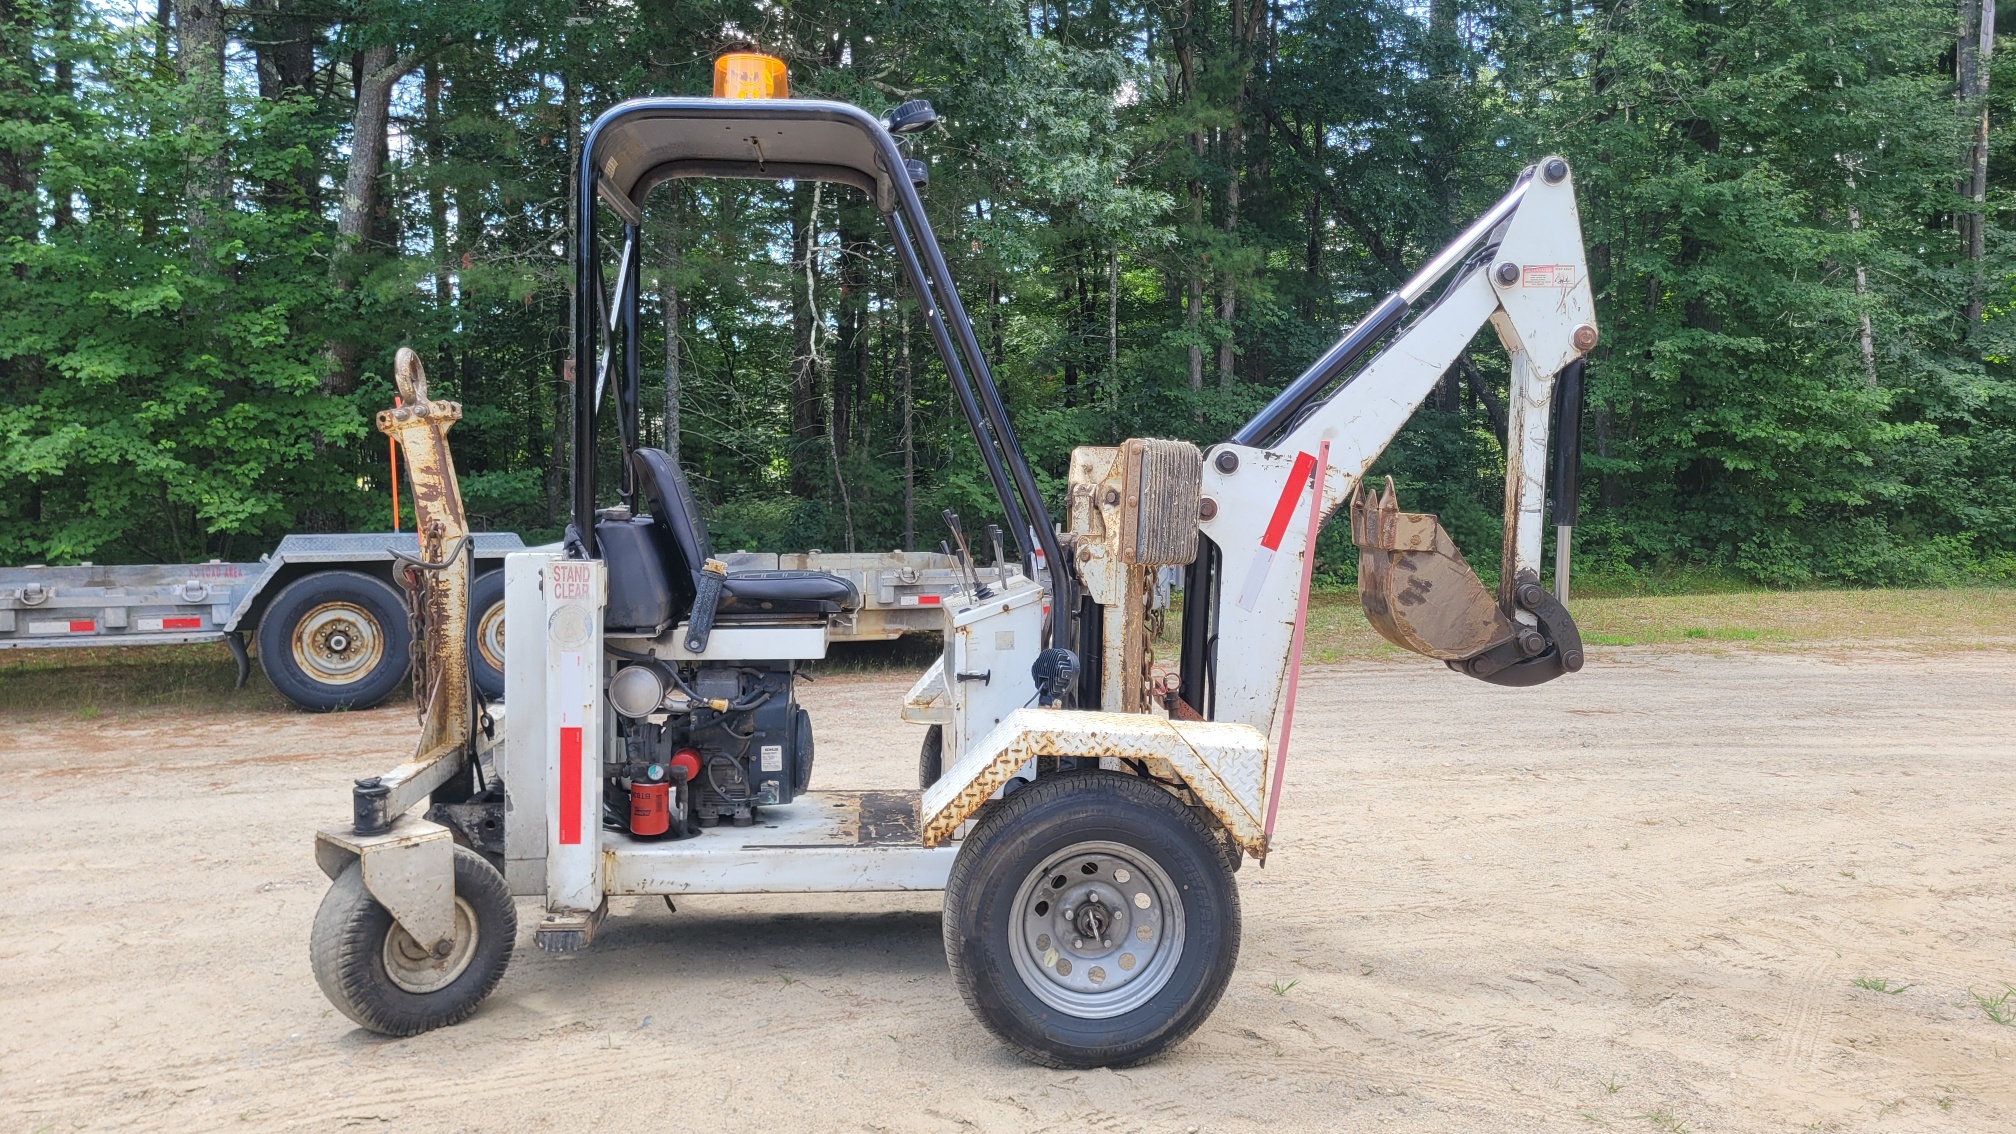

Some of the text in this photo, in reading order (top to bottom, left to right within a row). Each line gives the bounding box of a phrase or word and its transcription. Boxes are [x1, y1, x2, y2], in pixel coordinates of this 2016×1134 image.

[202, 565, 221, 578] LOAD
[224, 565, 243, 578] AREA
[553, 565, 590, 583] STAND
[554, 582, 590, 600] CLEAR
